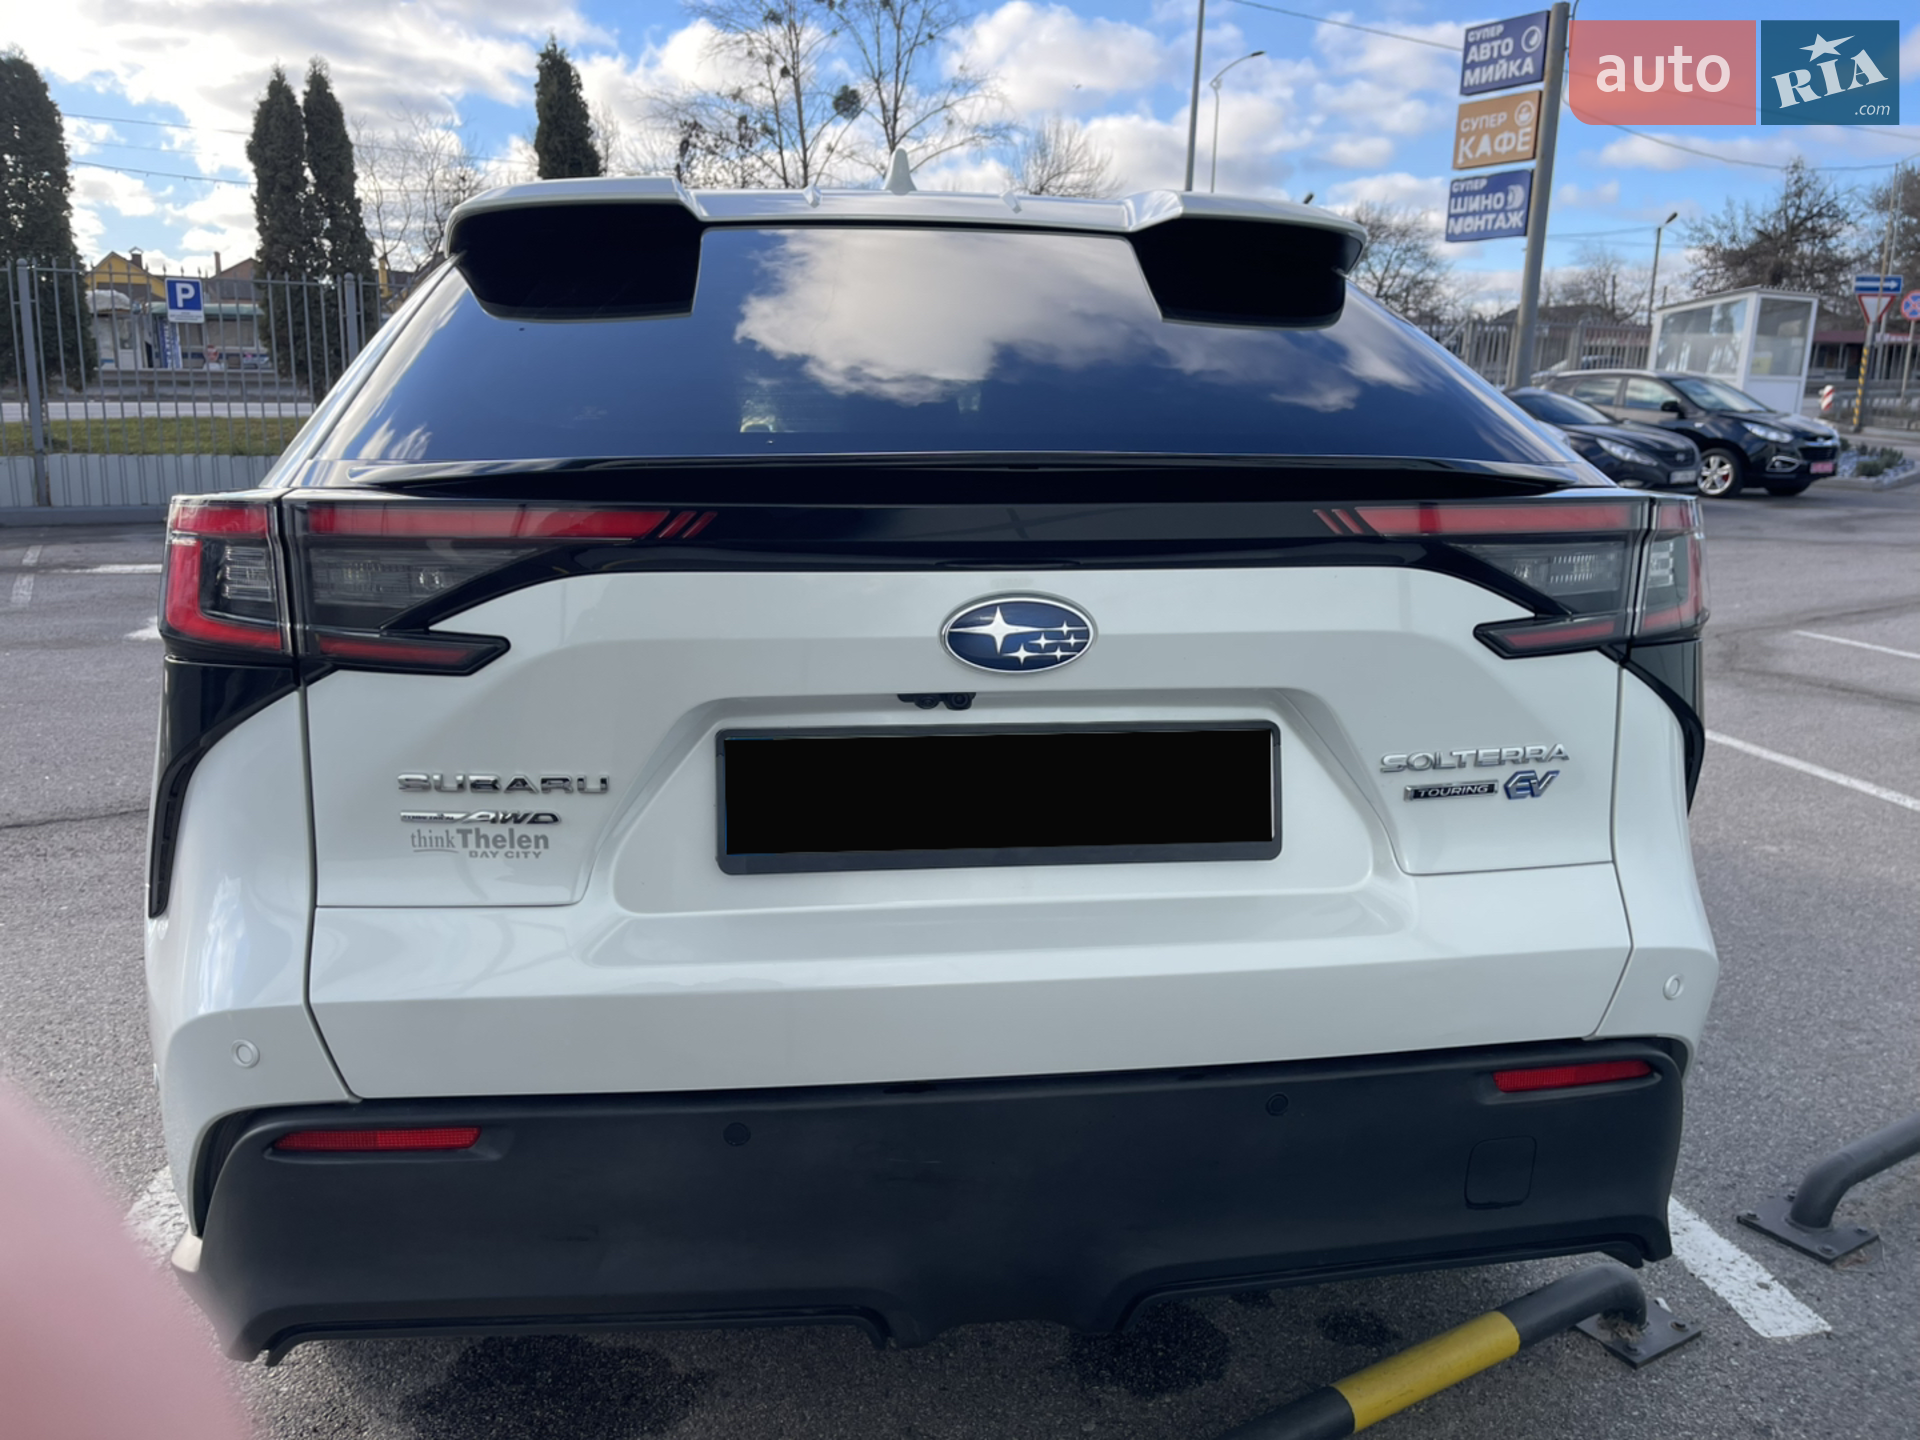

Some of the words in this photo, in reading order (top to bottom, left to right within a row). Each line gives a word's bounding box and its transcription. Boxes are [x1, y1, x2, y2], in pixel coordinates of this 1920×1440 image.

[1467, 24, 1504, 42] СУПЕР
[1466, 37, 1514, 64] АВТО
[1463, 57, 1534, 87] МИЙКА
[1460, 112, 1507, 132] СУПЕР
[1457, 127, 1532, 165] КАФЕ
[1451, 178, 1488, 193] СУПЕР
[1450, 192, 1504, 214] ШИНО
[1447, 210, 1525, 235] МОНТАЖ
[175, 282, 195, 308] P
[1380, 743, 1570, 773] SOLTERRA
[397, 773, 610, 794] SUBARU
[1418, 784, 1490, 798] TOURING
[1503, 770, 1561, 800] EV
[461, 810, 561, 825] AWD
[411, 828, 455, 849] think
[456, 828, 550, 849] Thelen
[469, 851, 499, 859] BAY
[504, 851, 542, 859] CITY
